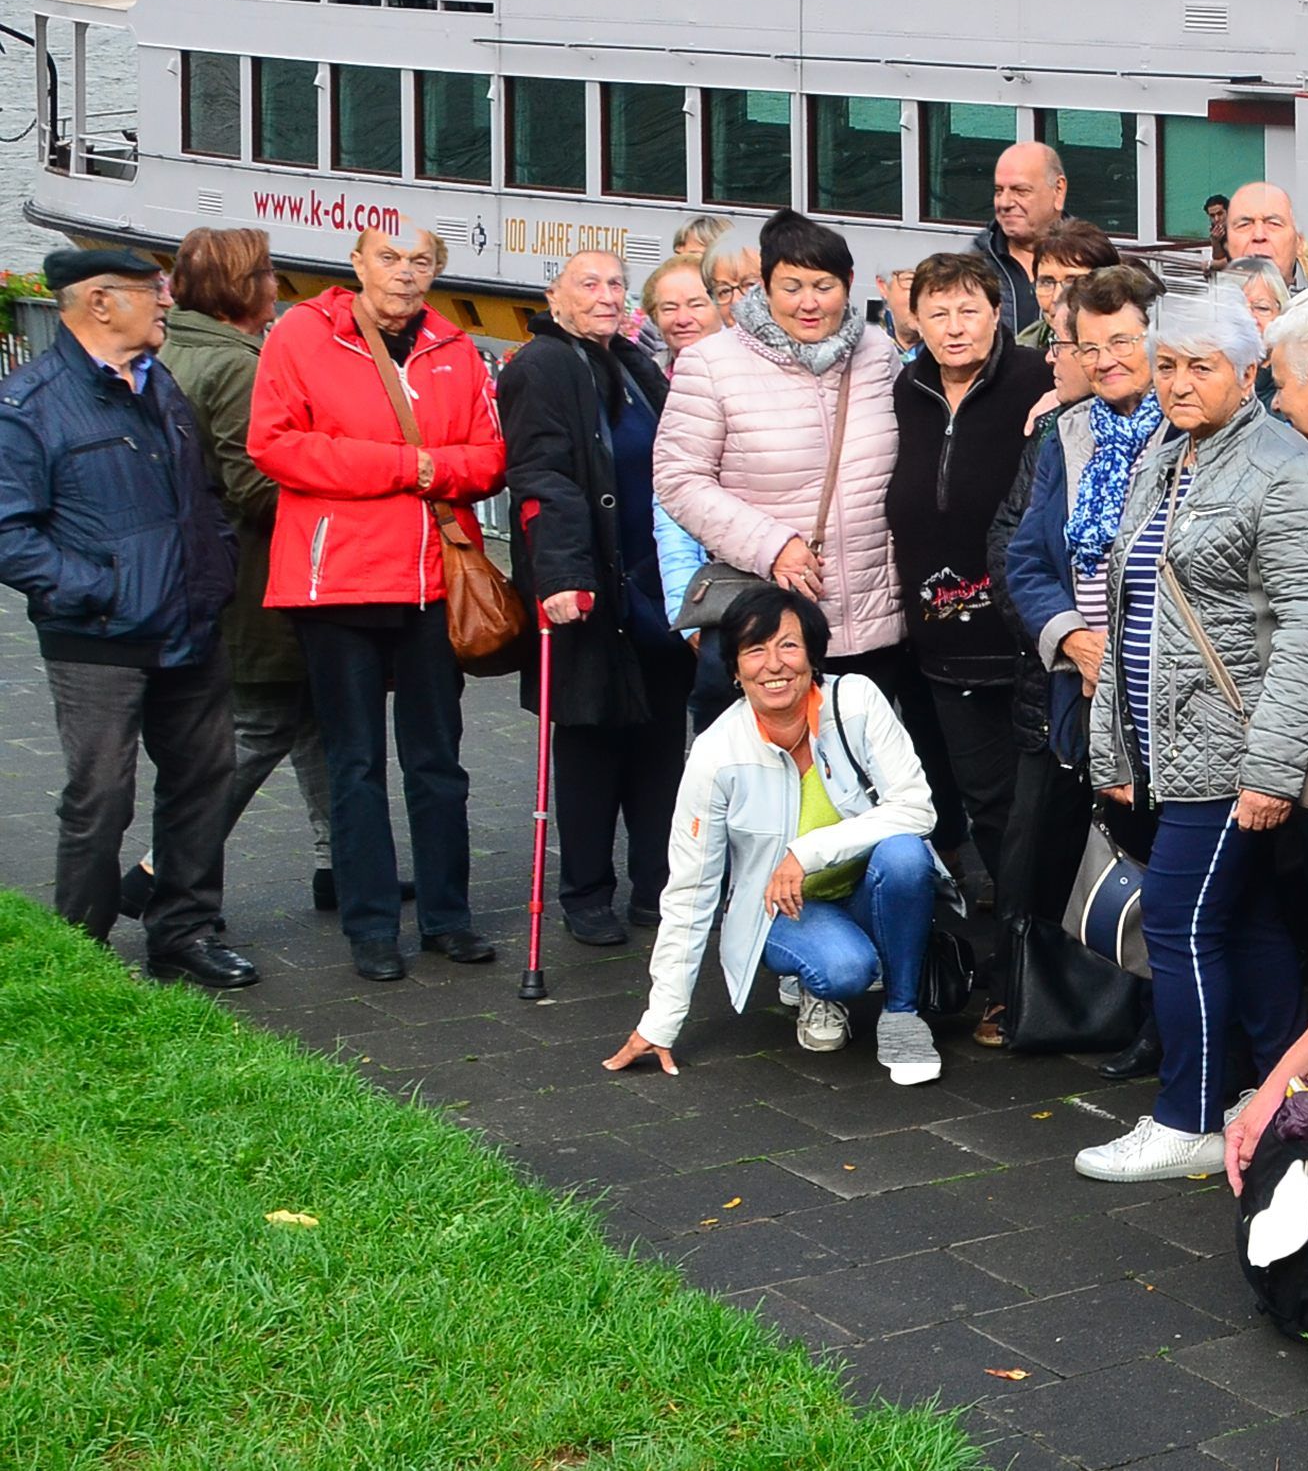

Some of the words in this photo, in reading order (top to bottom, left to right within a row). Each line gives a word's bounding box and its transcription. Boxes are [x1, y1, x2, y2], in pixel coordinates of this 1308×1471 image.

[254, 189, 400, 237] www.k-d.com
[505, 218, 526, 253] 100
[531, 220, 573, 258] JAHRE
[578, 224, 629, 263] GOETHE
